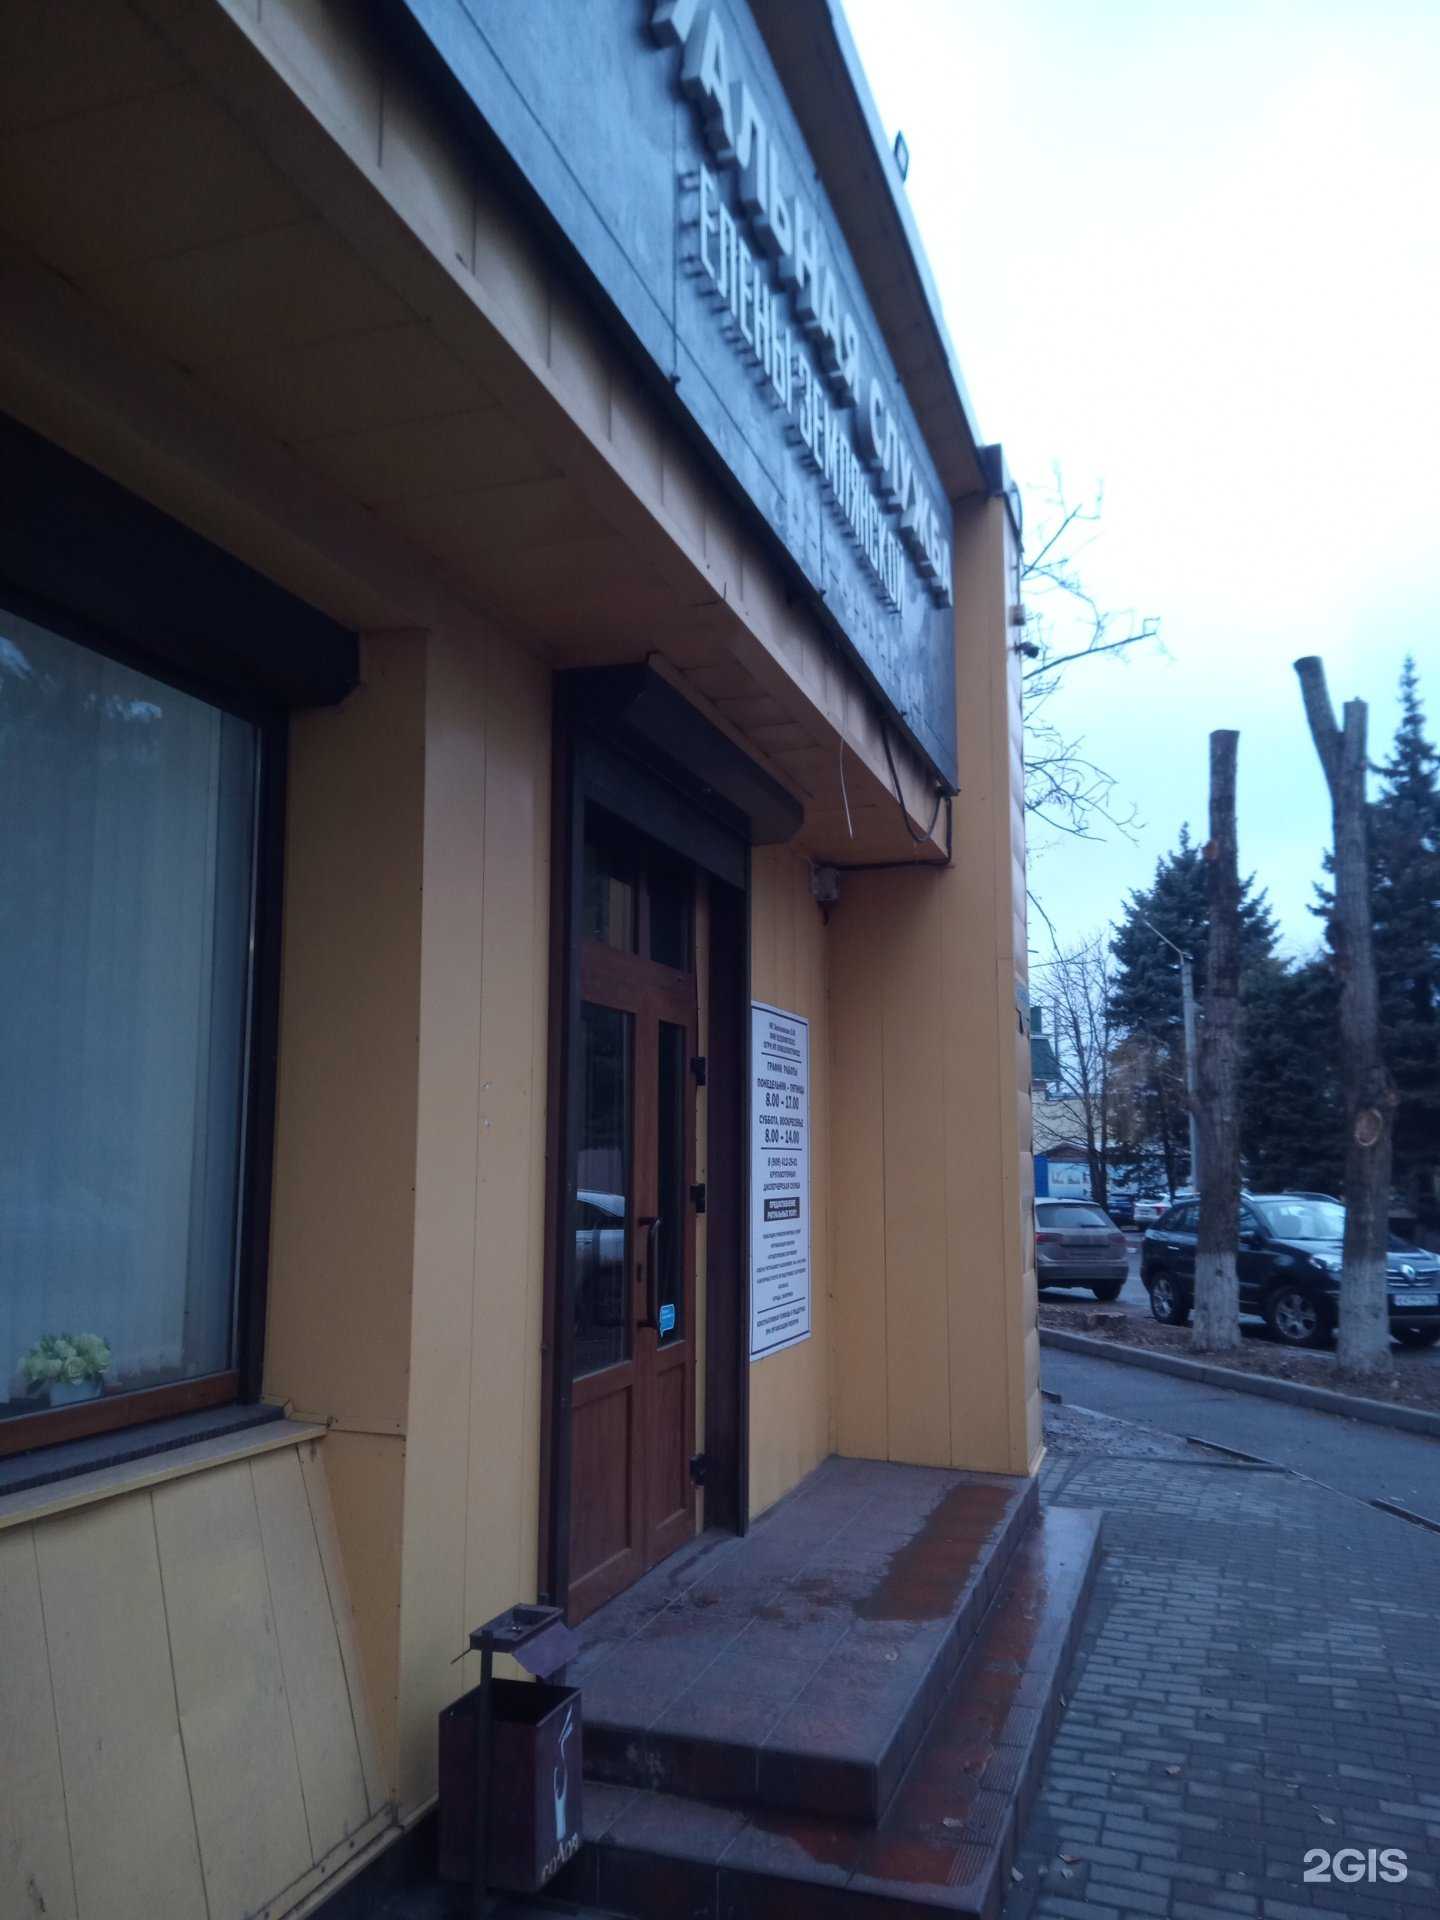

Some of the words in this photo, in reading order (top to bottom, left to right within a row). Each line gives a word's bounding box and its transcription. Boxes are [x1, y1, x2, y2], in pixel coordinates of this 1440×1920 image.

[701, 162, 792, 415] ЕЛЕНЫ
[799, 350, 904, 611] ЗЕМЛЯНСКОЙ
[870, 378, 953, 608] СЛУЖБА
[757, 1077, 786, 1090] ПОНЕДЕЛЬНИК
[765, 1092, 779, 1107] 8.00
[785, 1095, 799, 1110] 17.00
[765, 1128, 779, 1143] 8.00
[785, 1129, 799, 1145] 14.00
